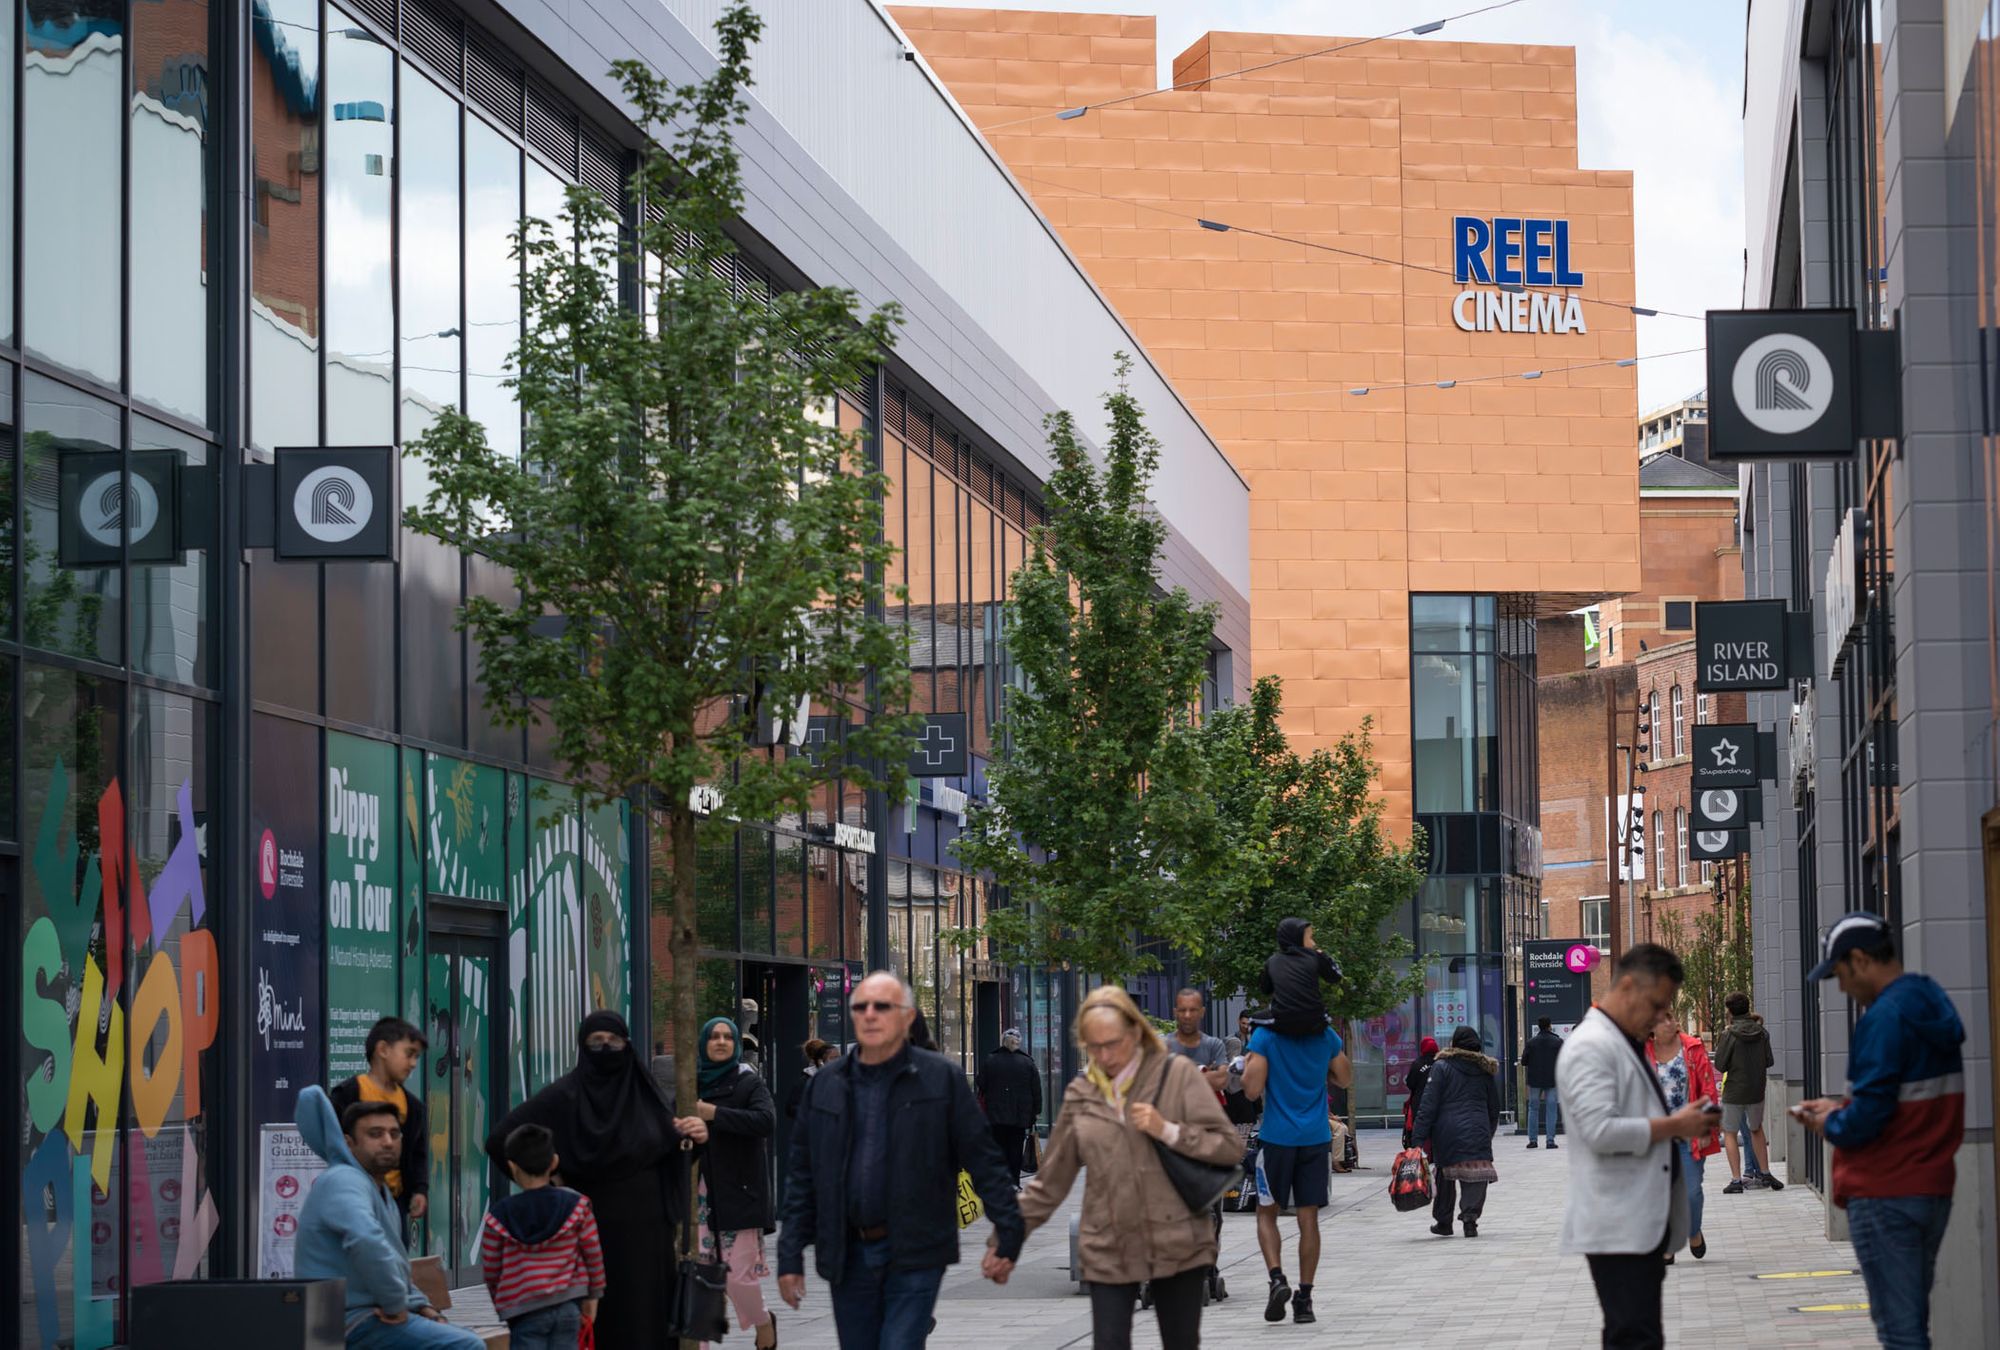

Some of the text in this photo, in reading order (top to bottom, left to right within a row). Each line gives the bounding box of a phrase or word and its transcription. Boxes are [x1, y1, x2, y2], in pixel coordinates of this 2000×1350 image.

[1453, 215, 1584, 287] REEL
[1452, 290, 1587, 334] CINEMA
[1714, 641, 1770, 661] RIVER
[1707, 662, 1778, 682] ISLAND
[1699, 767, 1752, 776] Superdrug
[329, 767, 379, 862] Dippy
[280, 848, 305, 868] Rochdale
[280, 868, 305, 888] Riverside
[329, 863, 392, 932] on Tour
[1529, 952, 1564, 961] Rochdale
[1529, 960, 1563, 969] Riverside
[22, 917, 220, 1197] SHOP
